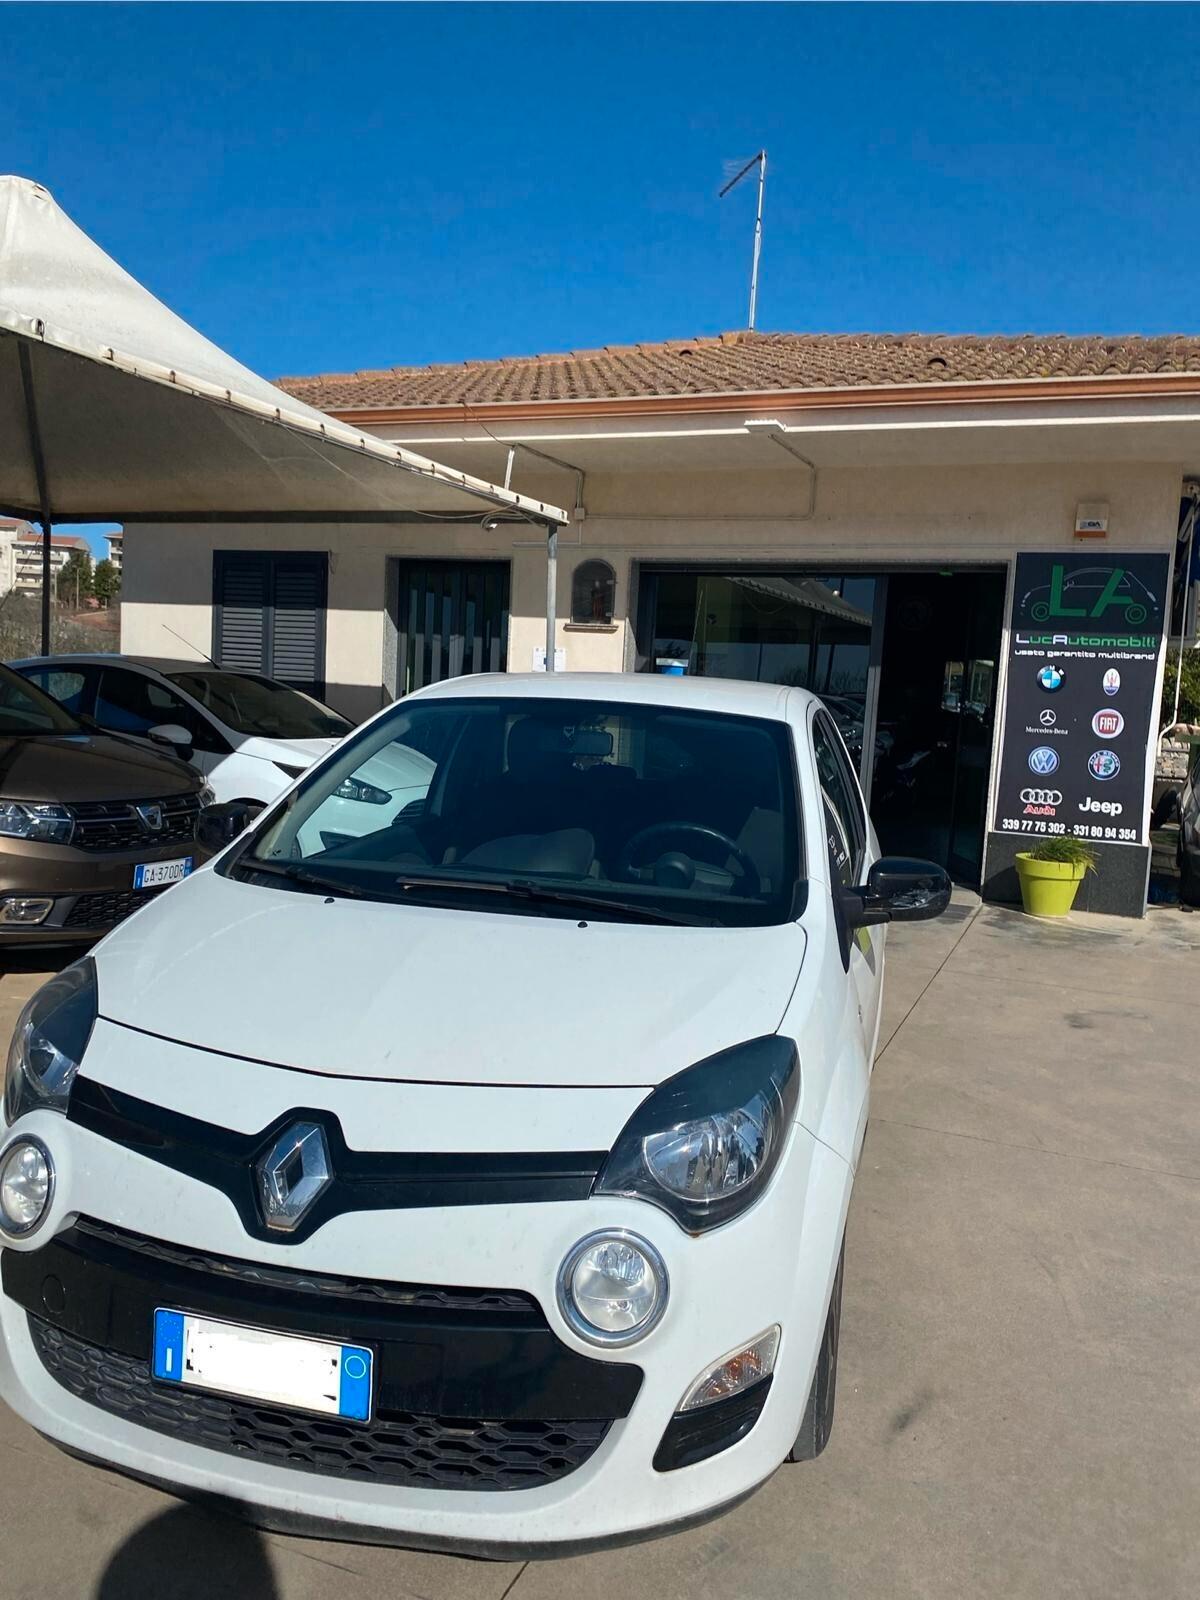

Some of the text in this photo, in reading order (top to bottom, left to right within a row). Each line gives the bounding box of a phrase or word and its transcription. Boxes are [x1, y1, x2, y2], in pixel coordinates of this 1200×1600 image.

[1099, 717, 1118, 730] FIAT
[1025, 726, 1068, 735] Mercedes-Benz
[1023, 804, 1056, 816] Audi
[1078, 797, 1123, 817] Jeep
[1002, 818, 1020, 830] 339
[1021, 820, 1034, 831] 77
[1034, 820, 1047, 832] 75
[1048, 822, 1066, 834] 302
[1073, 825, 1090, 836] 331
[1091, 826, 1103, 838] 80
[1104, 827, 1117, 839] 94
[1118, 828, 1137, 840] 354
